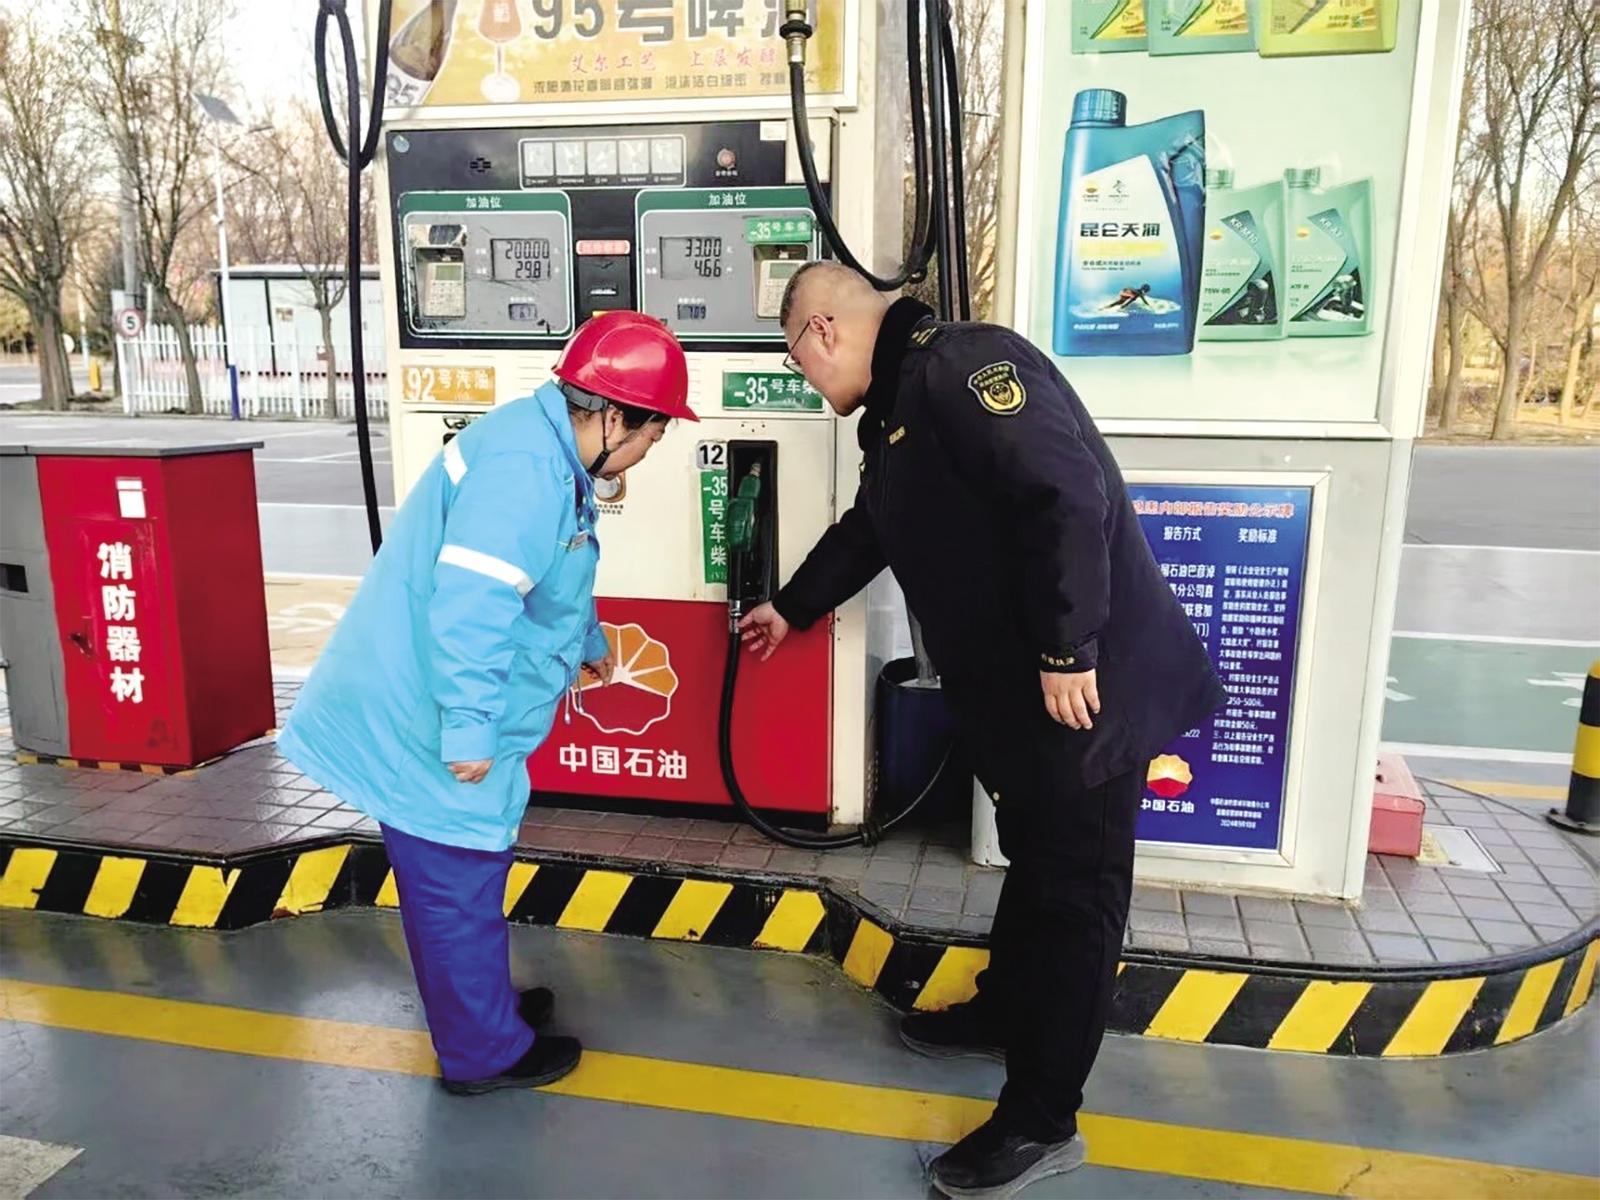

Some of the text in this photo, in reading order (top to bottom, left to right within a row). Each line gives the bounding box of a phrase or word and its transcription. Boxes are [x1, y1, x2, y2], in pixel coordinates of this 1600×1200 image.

[532, 0, 817, 44] 95号啤
[465, 195, 502, 210] 加油位
[709, 193, 747, 206] 加油位
[1080, 222, 1161, 238] 昆仑天润
[505, 240, 550, 260] 200.00
[684, 237, 722, 258] 33.00
[515, 260, 551, 279] 29.81
[693, 258, 722, 278] 4.66
[126, 315, 136, 330] 5
[700, 444, 724, 465] 12
[1163, 526, 1203, 542] 报告方式
[1237, 527, 1278, 544] 奖励标准
[1158, 563, 1216, 579] 国石油巴彦淖
[97, 541, 145, 704] 消防器材
[559, 742, 688, 780] 中国石油
[1140, 798, 1195, 814] 中国石油
